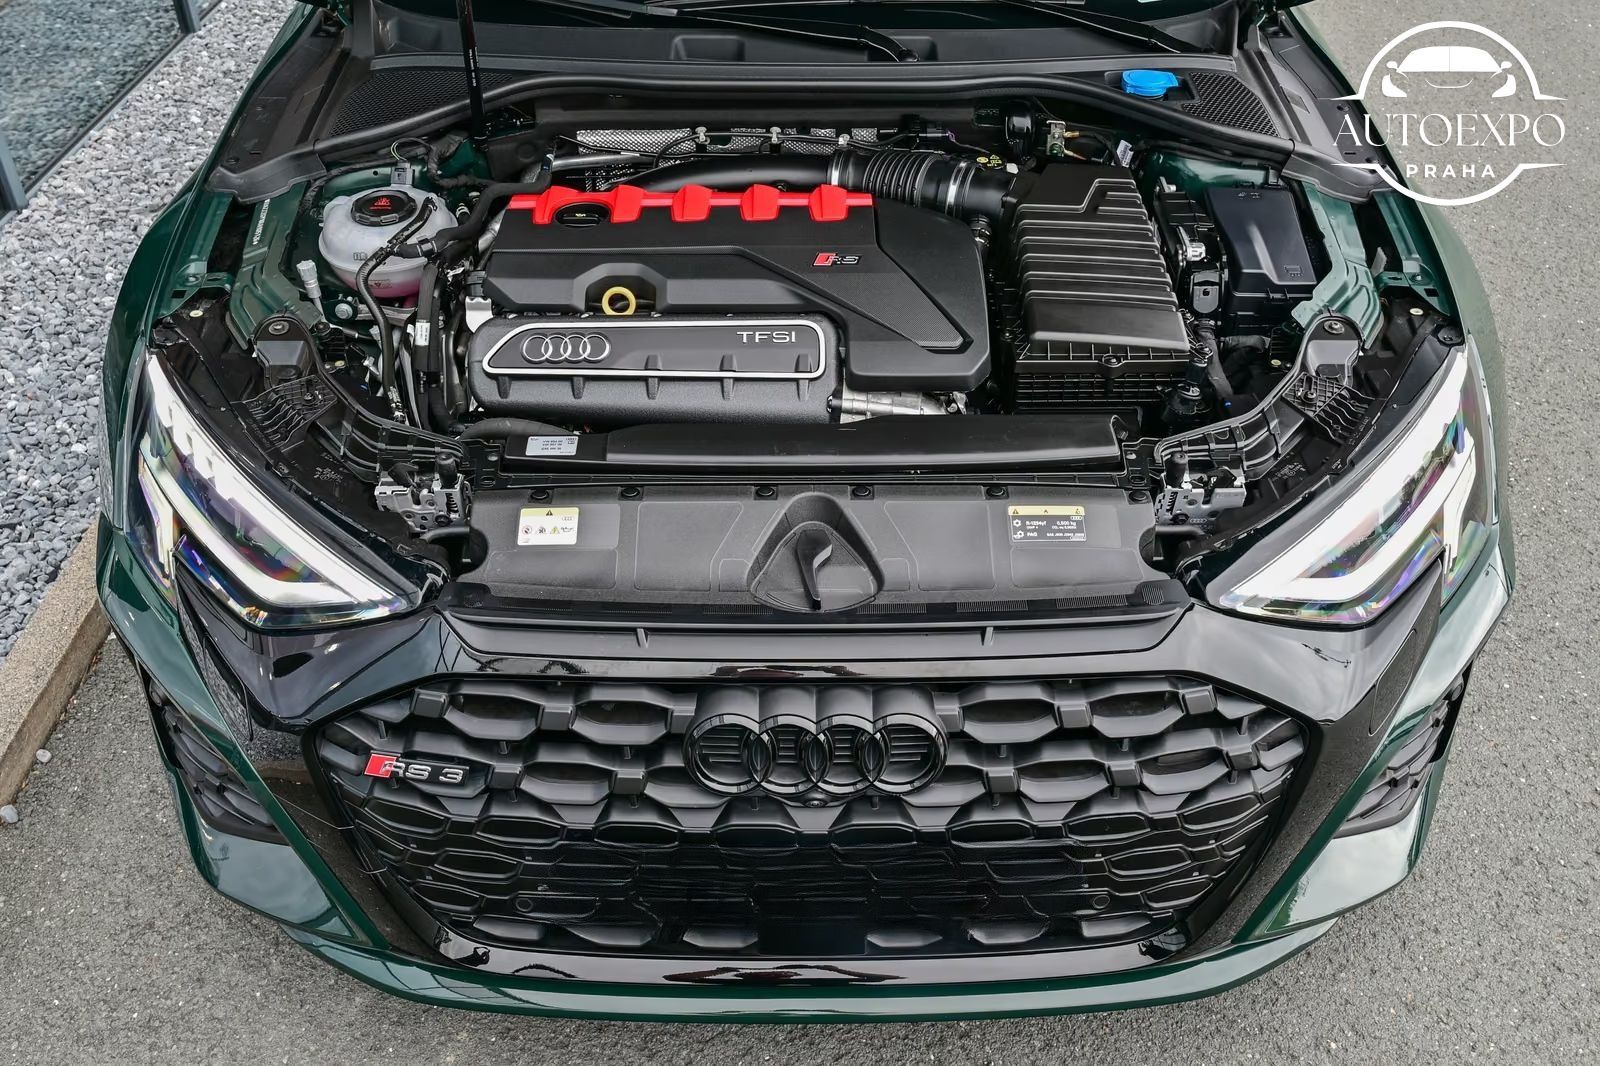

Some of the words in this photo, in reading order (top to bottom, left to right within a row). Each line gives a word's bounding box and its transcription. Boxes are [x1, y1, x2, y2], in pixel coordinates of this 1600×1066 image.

[822, 254, 860, 265] RS
[736, 331, 796, 343] TFSI
[376, 758, 432, 781] RS
[438, 768, 464, 784] 3
